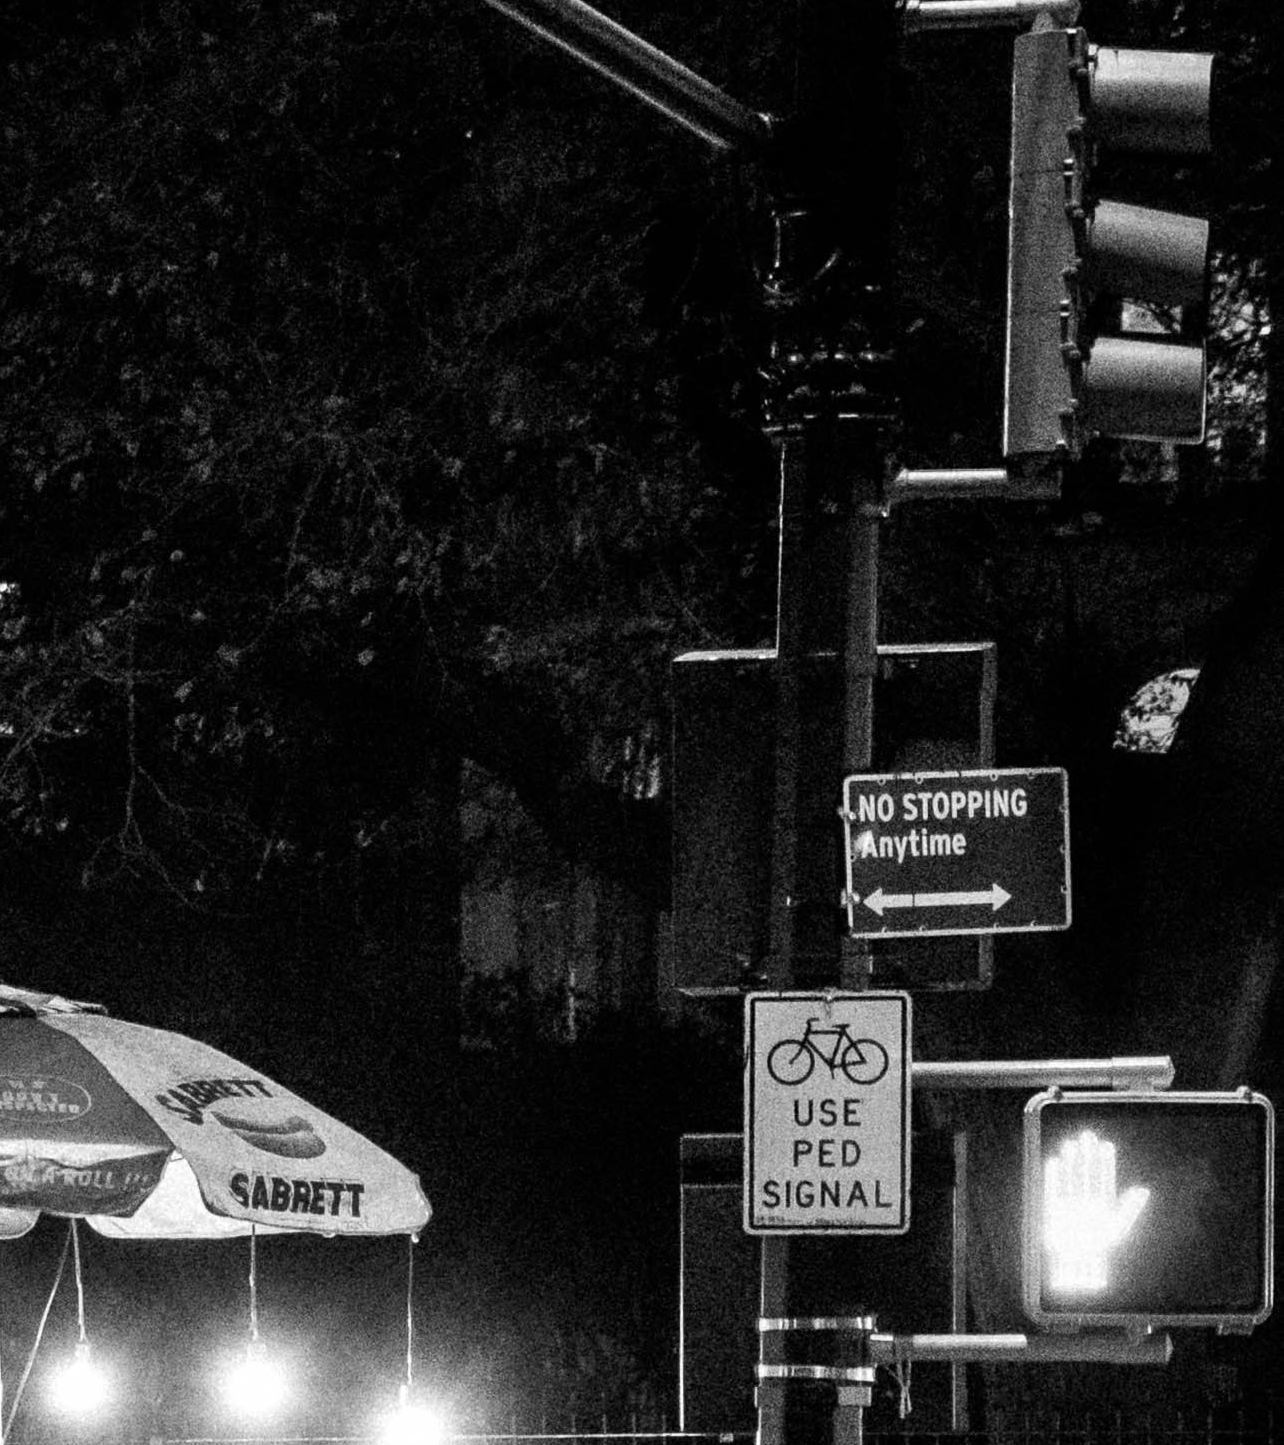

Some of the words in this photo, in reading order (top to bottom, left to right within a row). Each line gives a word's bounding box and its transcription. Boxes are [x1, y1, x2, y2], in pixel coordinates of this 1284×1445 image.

[859, 793, 895, 822] NO
[902, 788, 1028, 821] STOPPING
[861, 828, 968, 864] Anytime
[155, 1078, 274, 1126] SABRETT
[793, 1098, 862, 1127] USE
[792, 1139, 862, 1168] PED
[228, 1169, 366, 1218] SABRETT
[761, 1179, 894, 1209] SIGNAL
